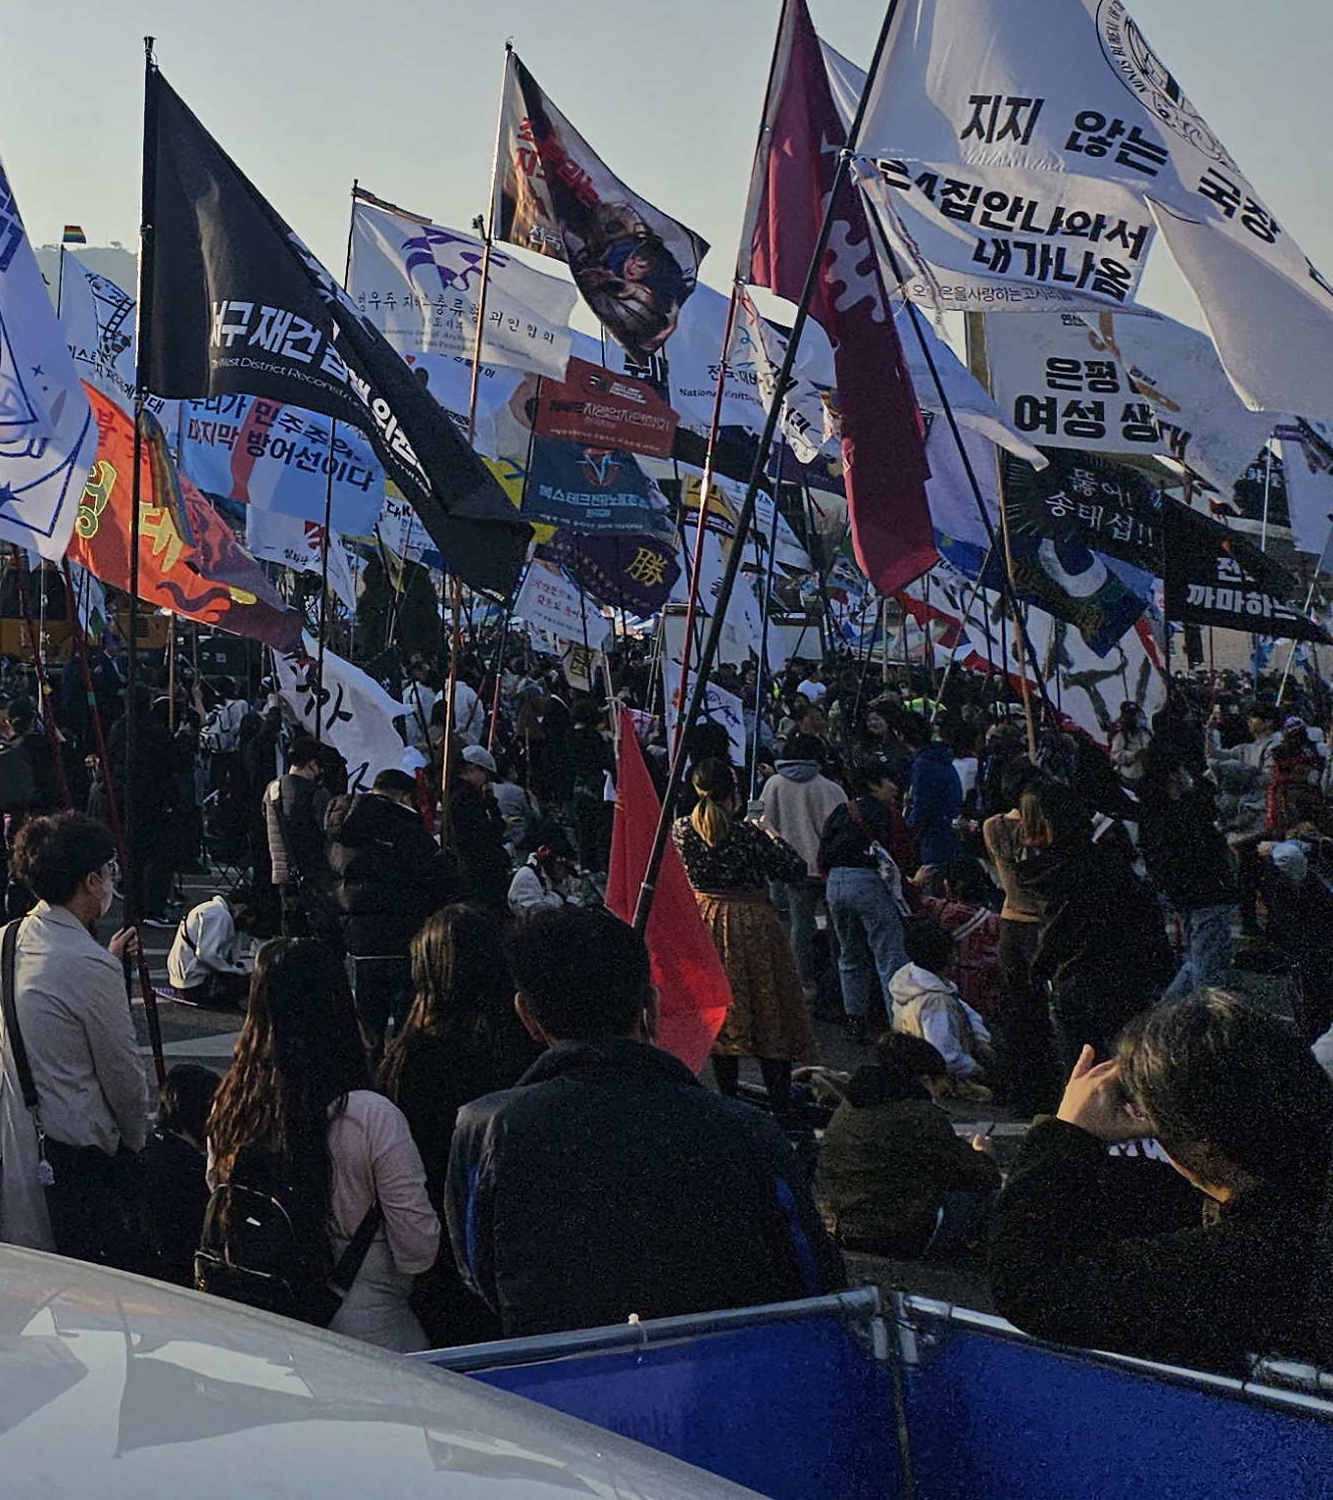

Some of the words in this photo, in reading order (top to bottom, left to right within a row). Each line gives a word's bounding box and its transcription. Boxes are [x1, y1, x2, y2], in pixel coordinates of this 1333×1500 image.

[1106, 22, 1126, 57] BUREAU
[1118, 59, 1150, 94] MINOS
[959, 94, 1045, 145] 지지
[1064, 109, 1170, 177] 않는
[1197, 166, 1282, 245] 국장
[972, 237, 1133, 303] 내가나옴
[240, 357, 286, 376] District
[1045, 356, 1121, 394] 은평
[1014, 394, 1107, 440] 여성
[187, 418, 240, 451] 마지막
[246, 429, 375, 493] 방어선이다
[624, 547, 668, 587] 勝
